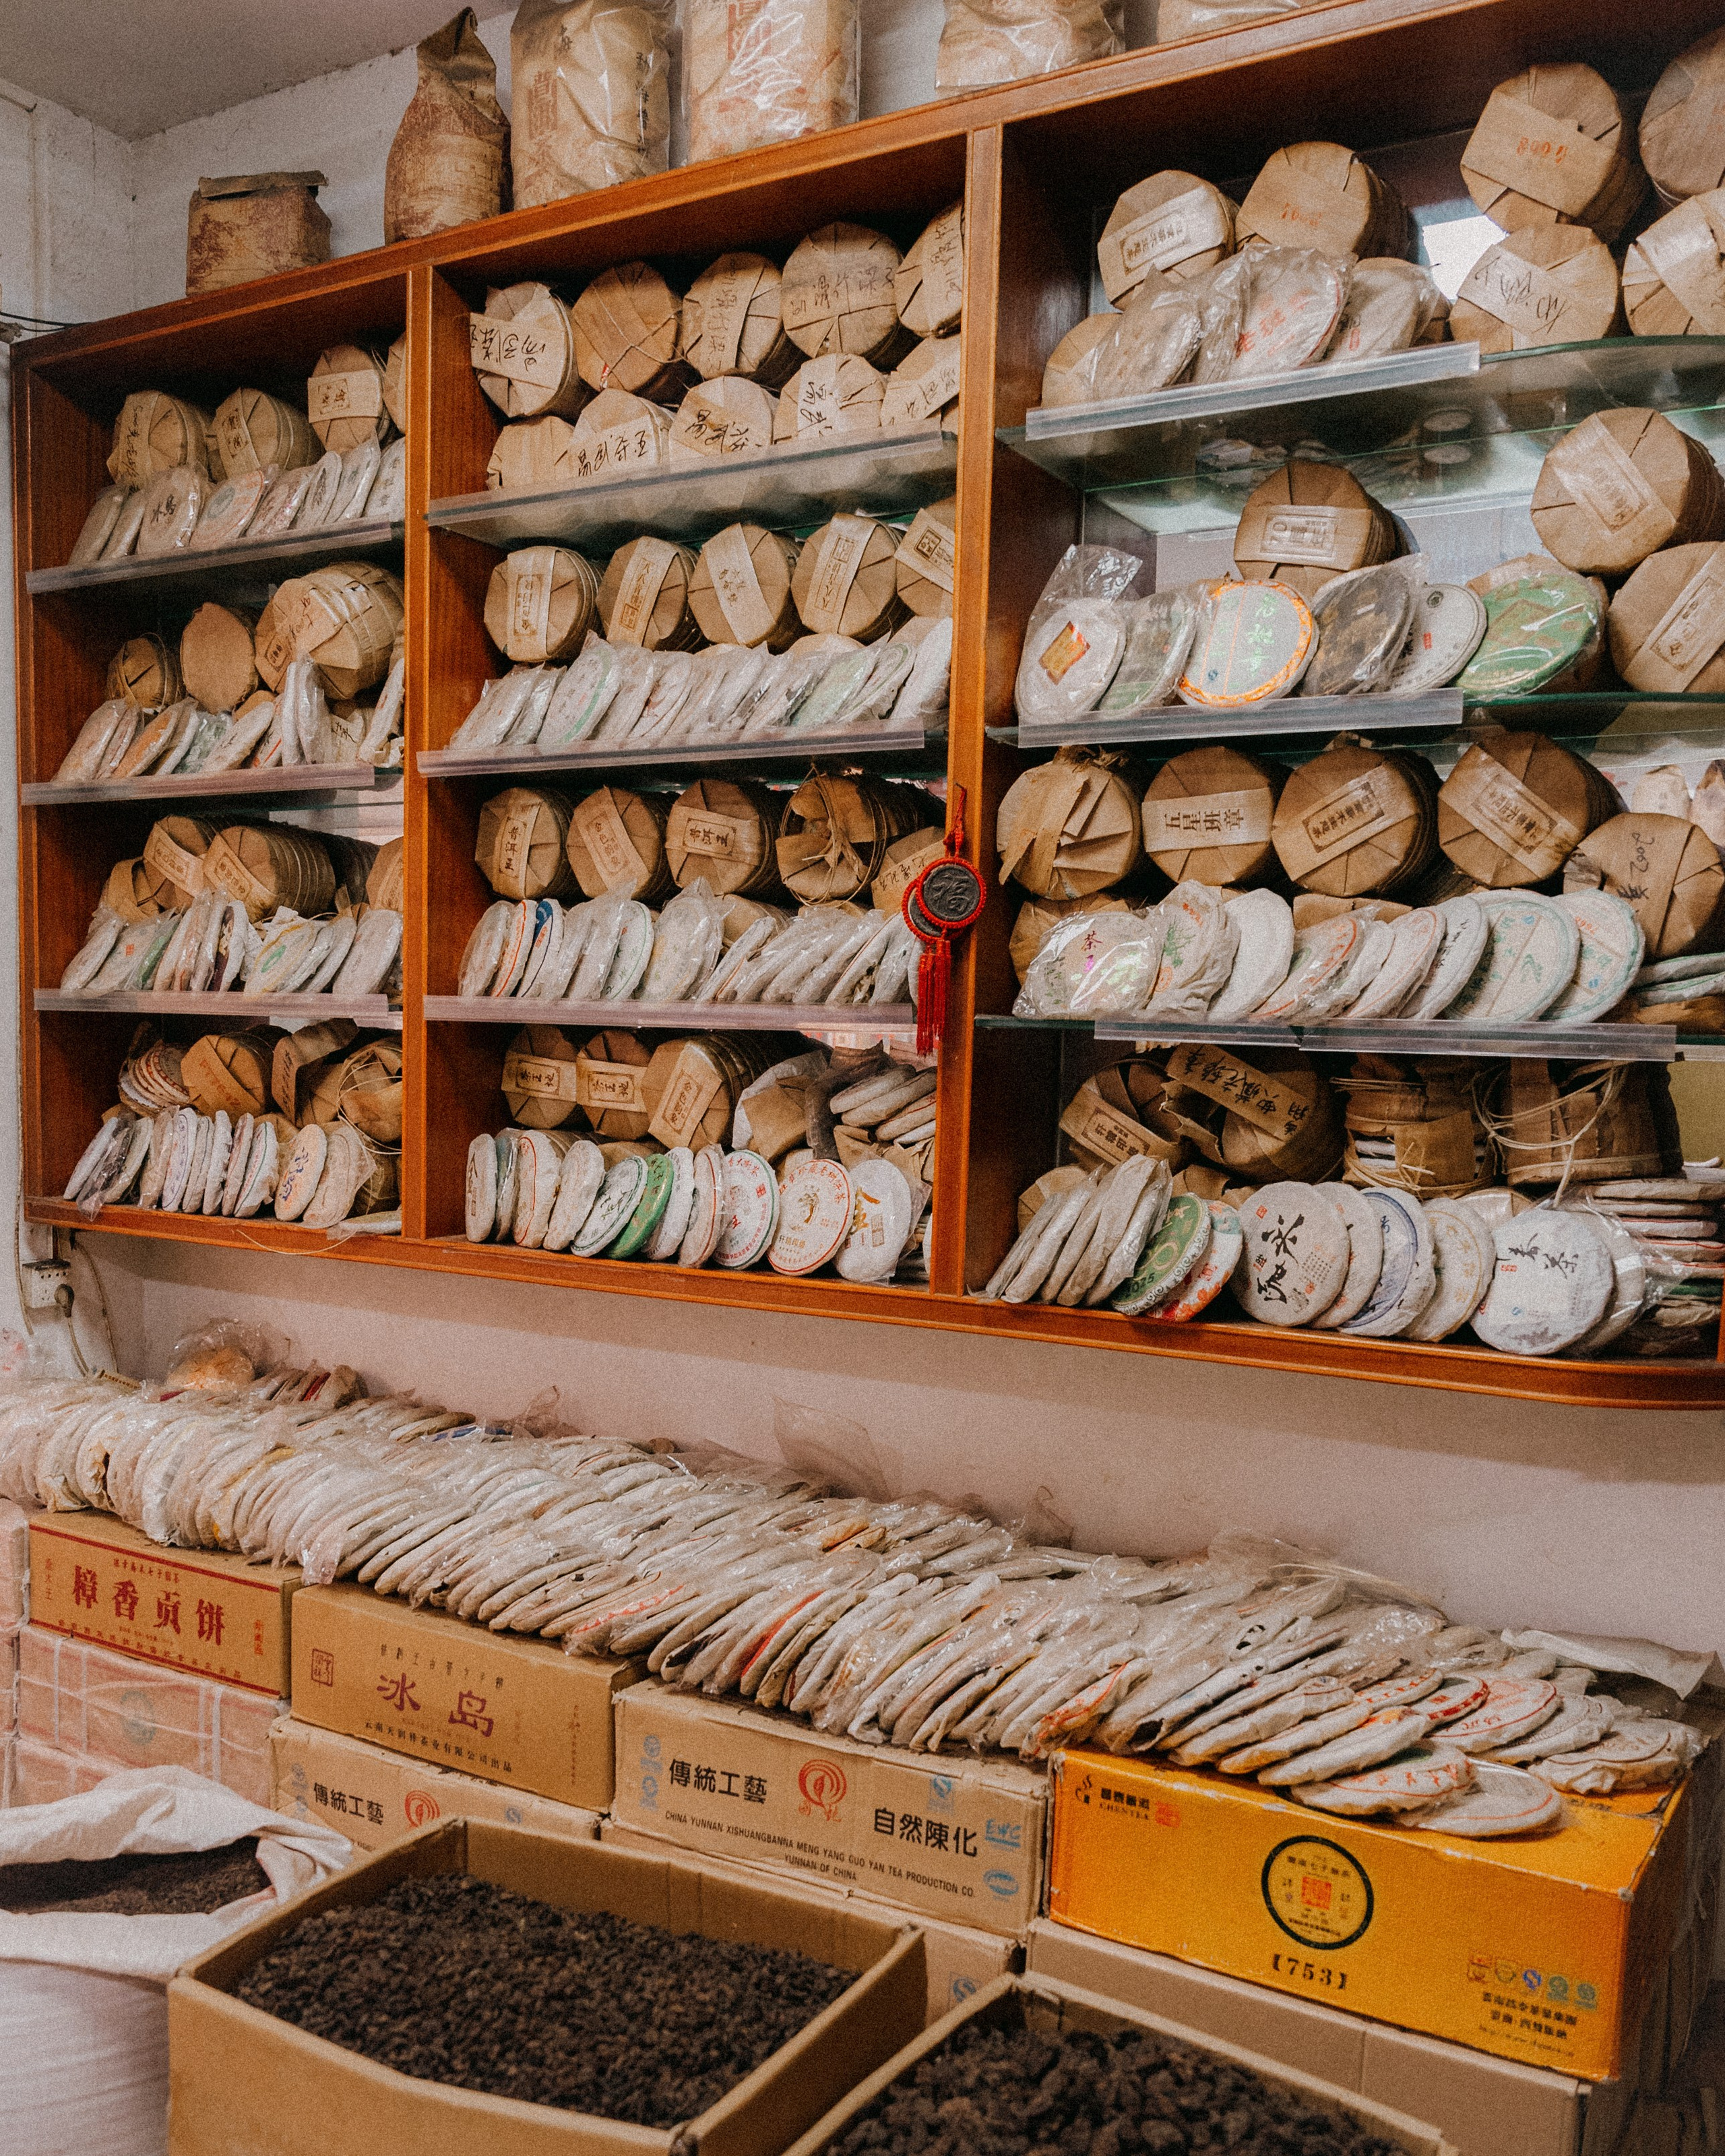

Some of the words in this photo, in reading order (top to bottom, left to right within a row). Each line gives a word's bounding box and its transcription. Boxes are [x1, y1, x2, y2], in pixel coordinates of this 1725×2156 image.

[1165, 808, 1245, 833] 五星班章
[376, 1672, 495, 1738] 冰岛
[313, 1781, 384, 1826] 傳統工藝
[669, 1758, 768, 1805] 傳統工藝
[665, 1810, 687, 1823] CHINA
[690, 1816, 723, 1833] YUNNAN
[726, 1825, 794, 1848] XISHUANGBANNA
[796, 1841, 819, 1856] MENG
[823, 1847, 845, 1862] YANG
[848, 1854, 865, 1868] GUO
[869, 1860, 885, 1873] YAN
[888, 1865, 903, 1878] TEA
[906, 1870, 958, 1894] PRODUCTION
[874, 1806, 979, 1858] 自然陳化
[784, 1852, 817, 1870] YUNNAN
[819, 1862, 830, 1872] OF
[833, 1866, 856, 1881] CHINA
